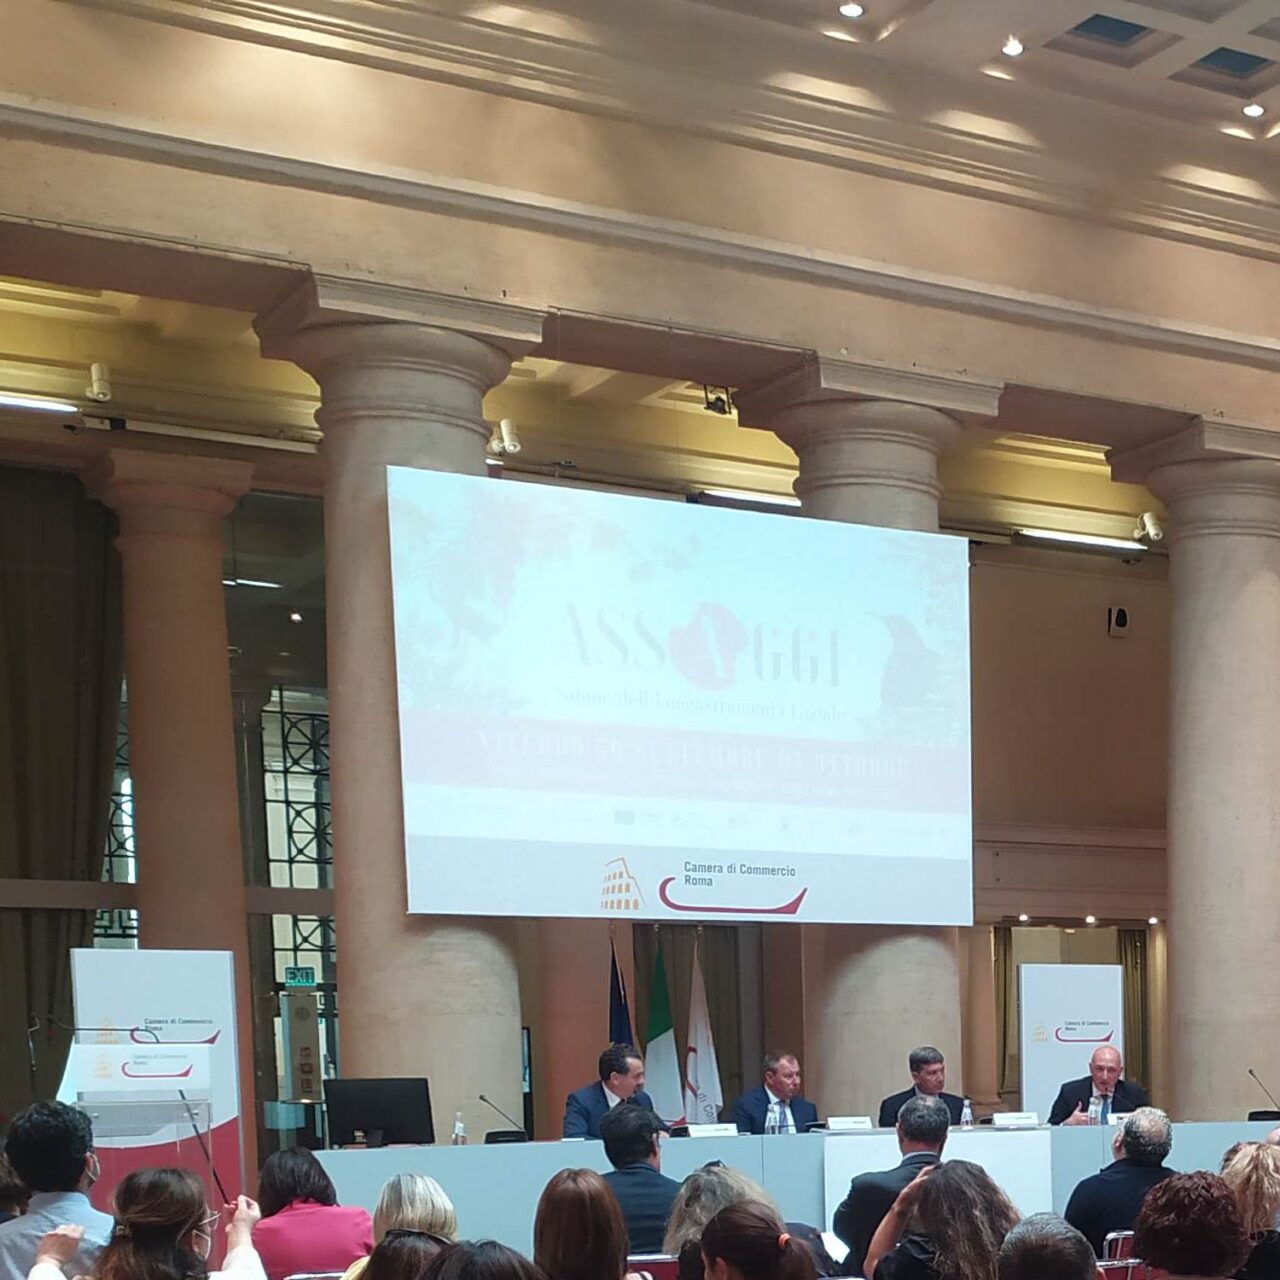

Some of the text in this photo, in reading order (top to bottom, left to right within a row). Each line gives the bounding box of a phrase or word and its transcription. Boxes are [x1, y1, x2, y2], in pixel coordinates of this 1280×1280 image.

[684, 861, 796, 877] Camera di Commercio
[684, 875, 713, 887] Roma
[287, 970, 313, 981] EXIT
